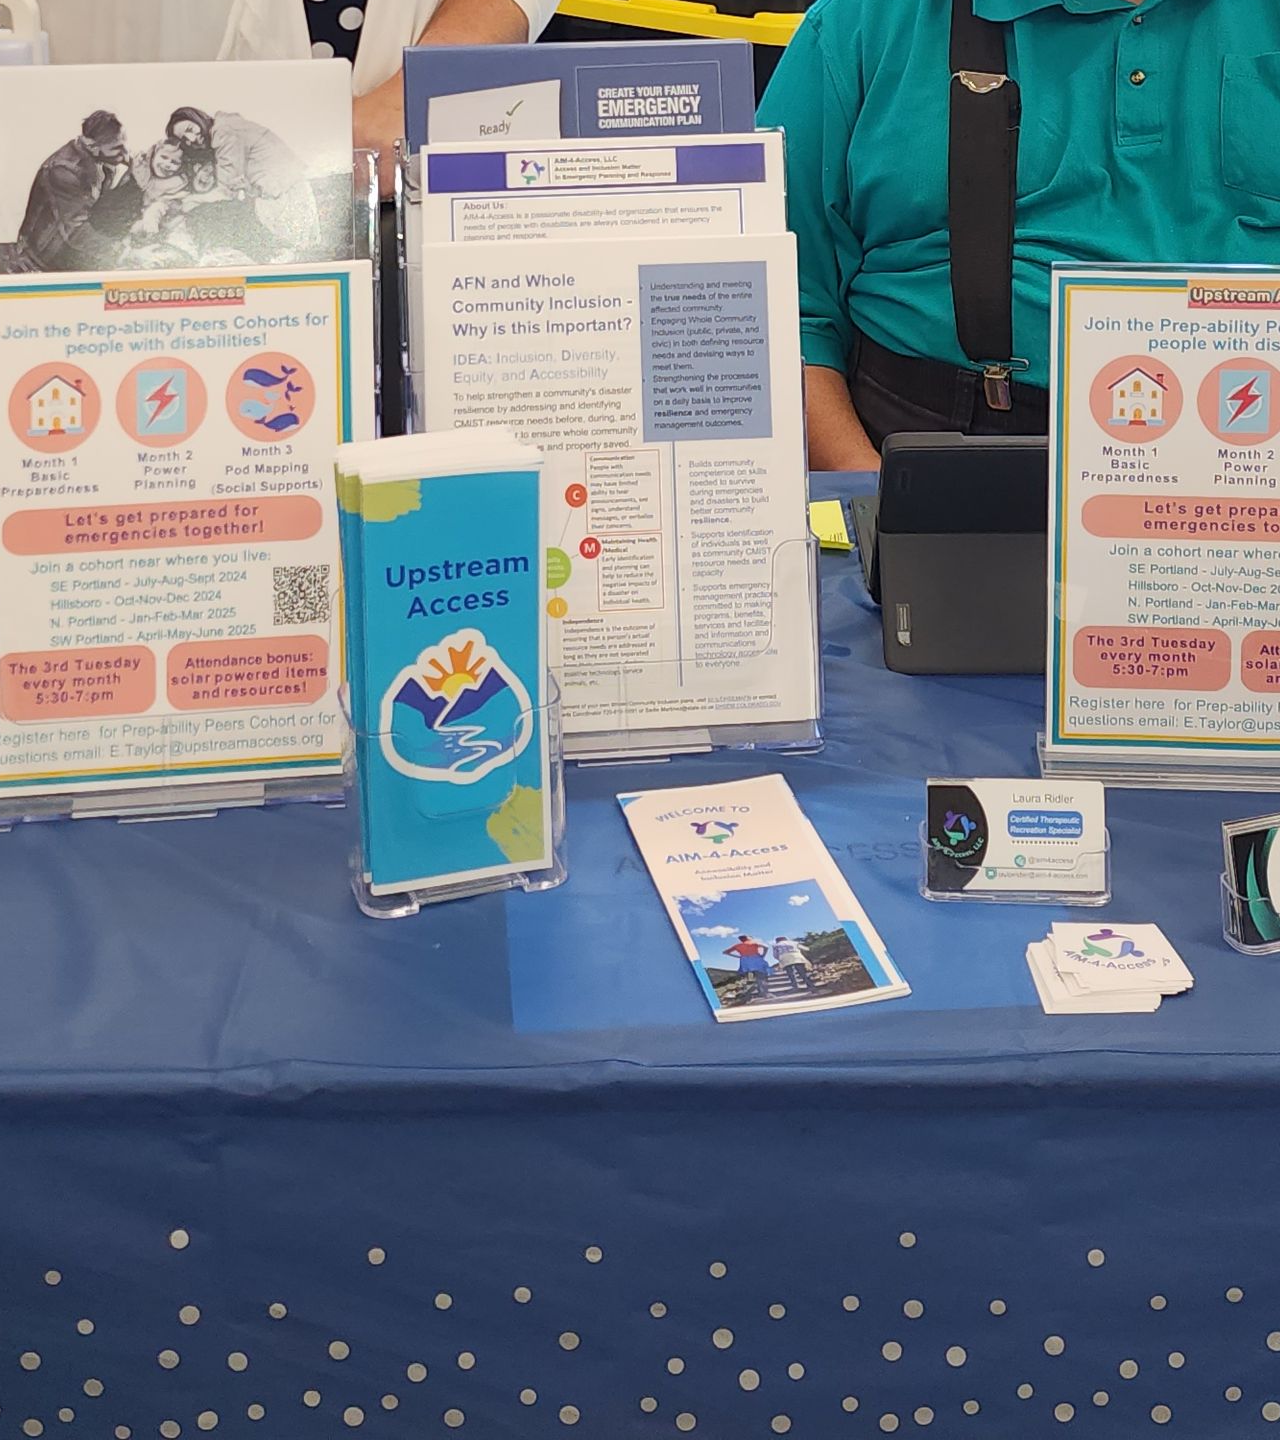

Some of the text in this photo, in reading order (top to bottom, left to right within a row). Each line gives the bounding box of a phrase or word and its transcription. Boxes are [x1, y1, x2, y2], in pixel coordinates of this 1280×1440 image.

[598, 84, 699, 98] CREATE YOUR FAMILY
[597, 96, 701, 117] EMERGENCY
[479, 121, 512, 136] Ready
[599, 115, 702, 129] COMMUNICATION PLAN
[463, 202, 490, 210] About
[452, 274, 575, 290] AFN and Whole
[105, 286, 245, 304] Upstream Access
[1190, 287, 1271, 303] Upstream
[452, 298, 543, 314] Community
[549, 295, 622, 310] Inclusion
[2, 312, 329, 340] Join the Prep-ability Peers Cohorts for
[453, 317, 632, 338] Why is this Important?
[1084, 317, 1121, 332] Join
[1127, 318, 1154, 333] the
[1160, 319, 1259, 336] Prep-ability
[1148, 339, 1207, 353] people
[1213, 337, 1249, 352] with
[453, 354, 492, 365] IDEA:
[502, 370, 525, 381] and
[530, 368, 608, 381] Accessibility
[1102, 446, 1157, 457] Month 1
[1217, 449, 1274, 459] Month 2
[1111, 459, 1149, 470] Basic
[1224, 462, 1268, 473] Power
[1082, 472, 1178, 484] Preparedness
[1214, 475, 1277, 488] Planning
[1144, 502, 1187, 514] Let's
[1194, 504, 1221, 517] get
[1144, 520, 1256, 534] emergencies
[1110, 544, 1138, 558] Join
[1144, 547, 1152, 557] a
[1157, 546, 1202, 558] cohort
[1207, 548, 1239, 559] near
[385, 553, 530, 592] Upstream
[407, 586, 510, 619] Access
[1088, 635, 1216, 651] The 3rd Tuesday
[1100, 651, 1196, 663] every month
[1113, 665, 1188, 678] 5:30-7:pm
[1070, 696, 1130, 711] Register
[1135, 698, 1165, 710] here
[1174, 699, 1192, 712] for
[1196, 699, 1274, 715] Prep-ability
[1069, 715, 1134, 728] questions
[1138, 716, 1179, 728] email:
[1013, 793, 1074, 803] Laura Ridler
[655, 806, 726, 822] WELCOME
[1040, 816, 1079, 824] Therapeutic
[1010, 826, 1081, 835] Recreation Specialist
[666, 844, 788, 864] AIM-4-Access
[1063, 950, 1156, 970] AIM-4-Access
